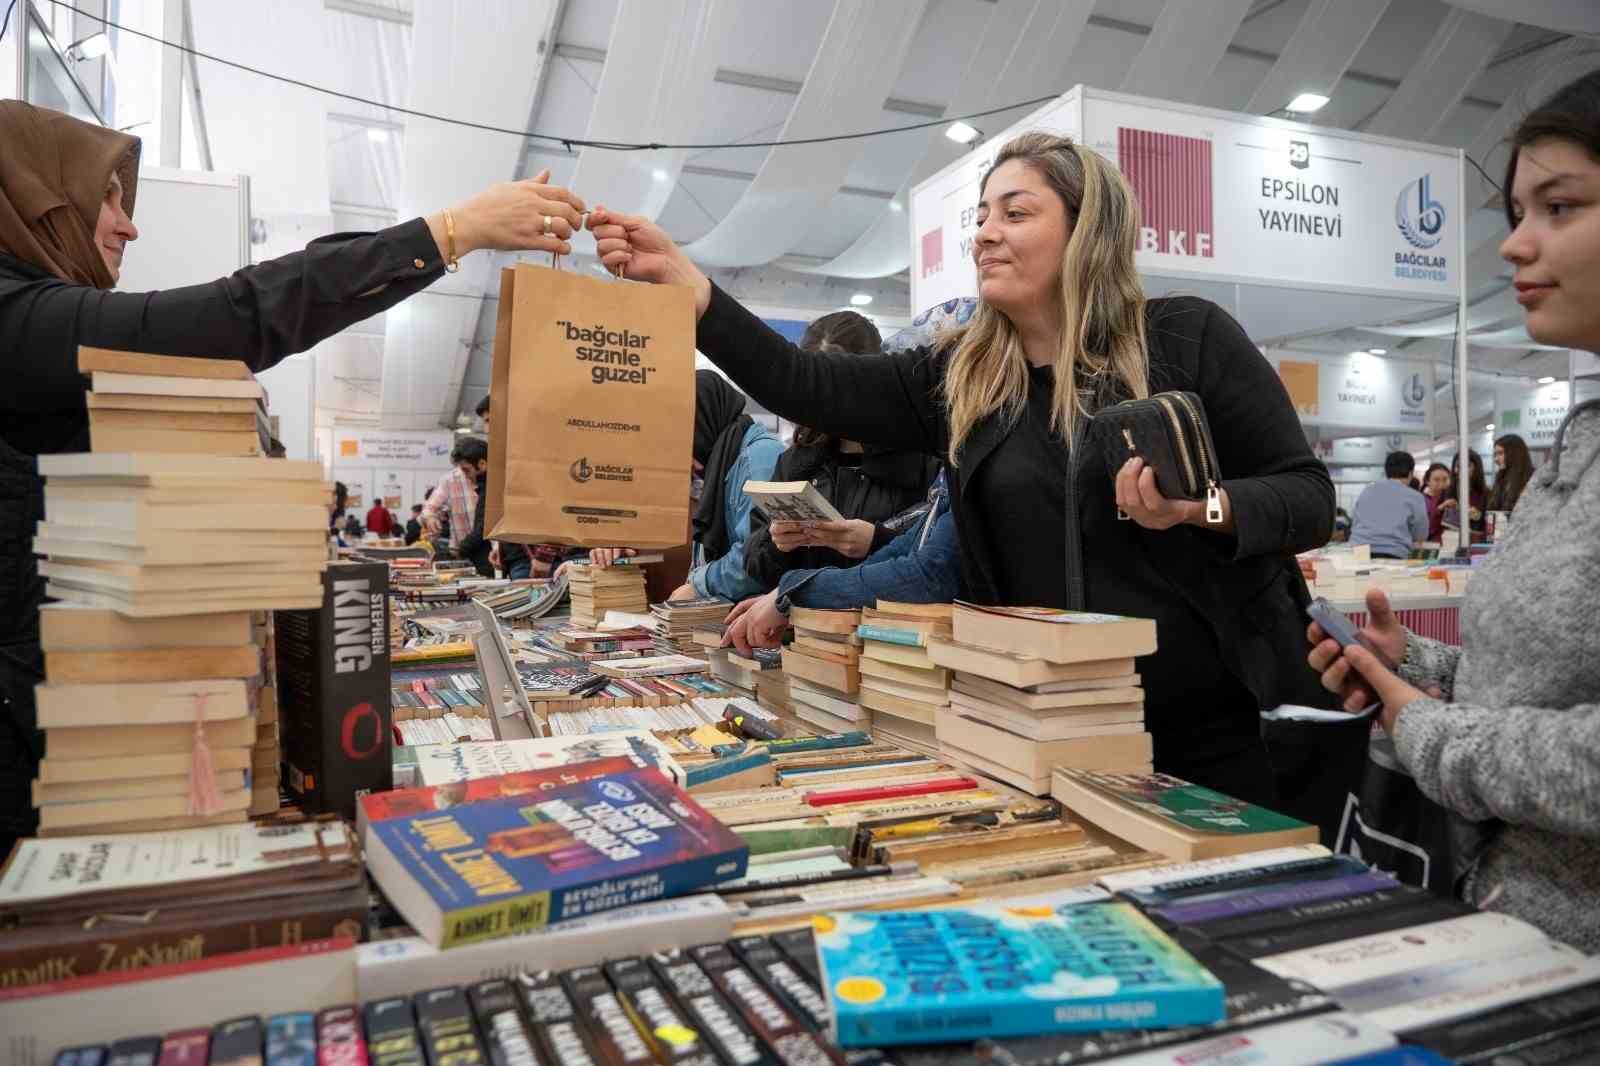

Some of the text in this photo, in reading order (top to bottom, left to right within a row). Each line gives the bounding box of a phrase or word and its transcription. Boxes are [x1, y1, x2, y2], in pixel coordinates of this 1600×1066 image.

[1262, 177, 1339, 206] EPSİLON
[1259, 208, 1342, 238] YAYINEVİ
[1140, 226, 1212, 256] BKF
[1395, 251, 1446, 268] BAĞCILAR
[334, 579, 372, 674] KING
[371, 593, 385, 655] STEPHEN
[453, 902, 544, 939] AHMET ÜMİT
